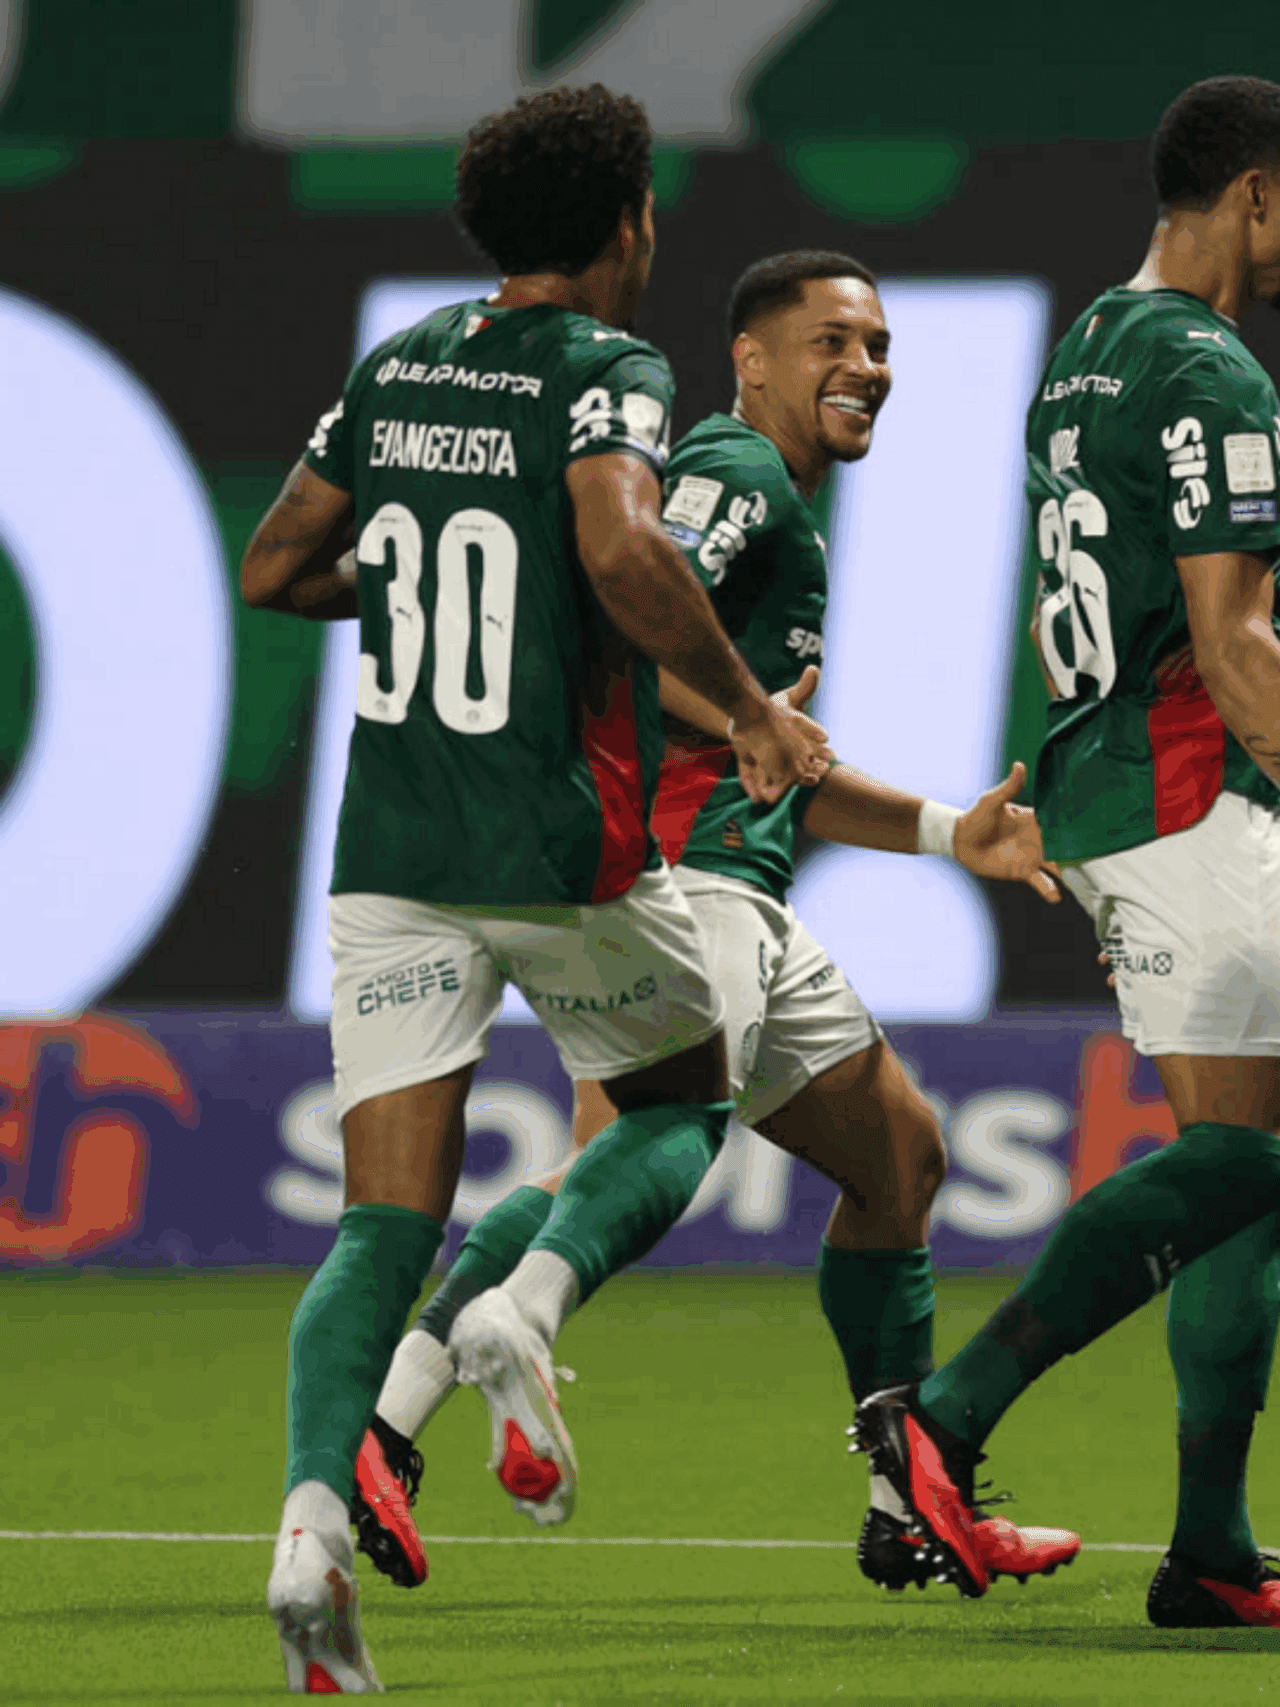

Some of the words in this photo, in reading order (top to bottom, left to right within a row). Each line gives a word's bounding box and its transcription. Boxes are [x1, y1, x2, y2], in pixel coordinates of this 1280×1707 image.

[356, 502, 519, 735] 30
[357, 967, 460, 1016] CHEFE
[377, 962, 432, 987] MOTO
